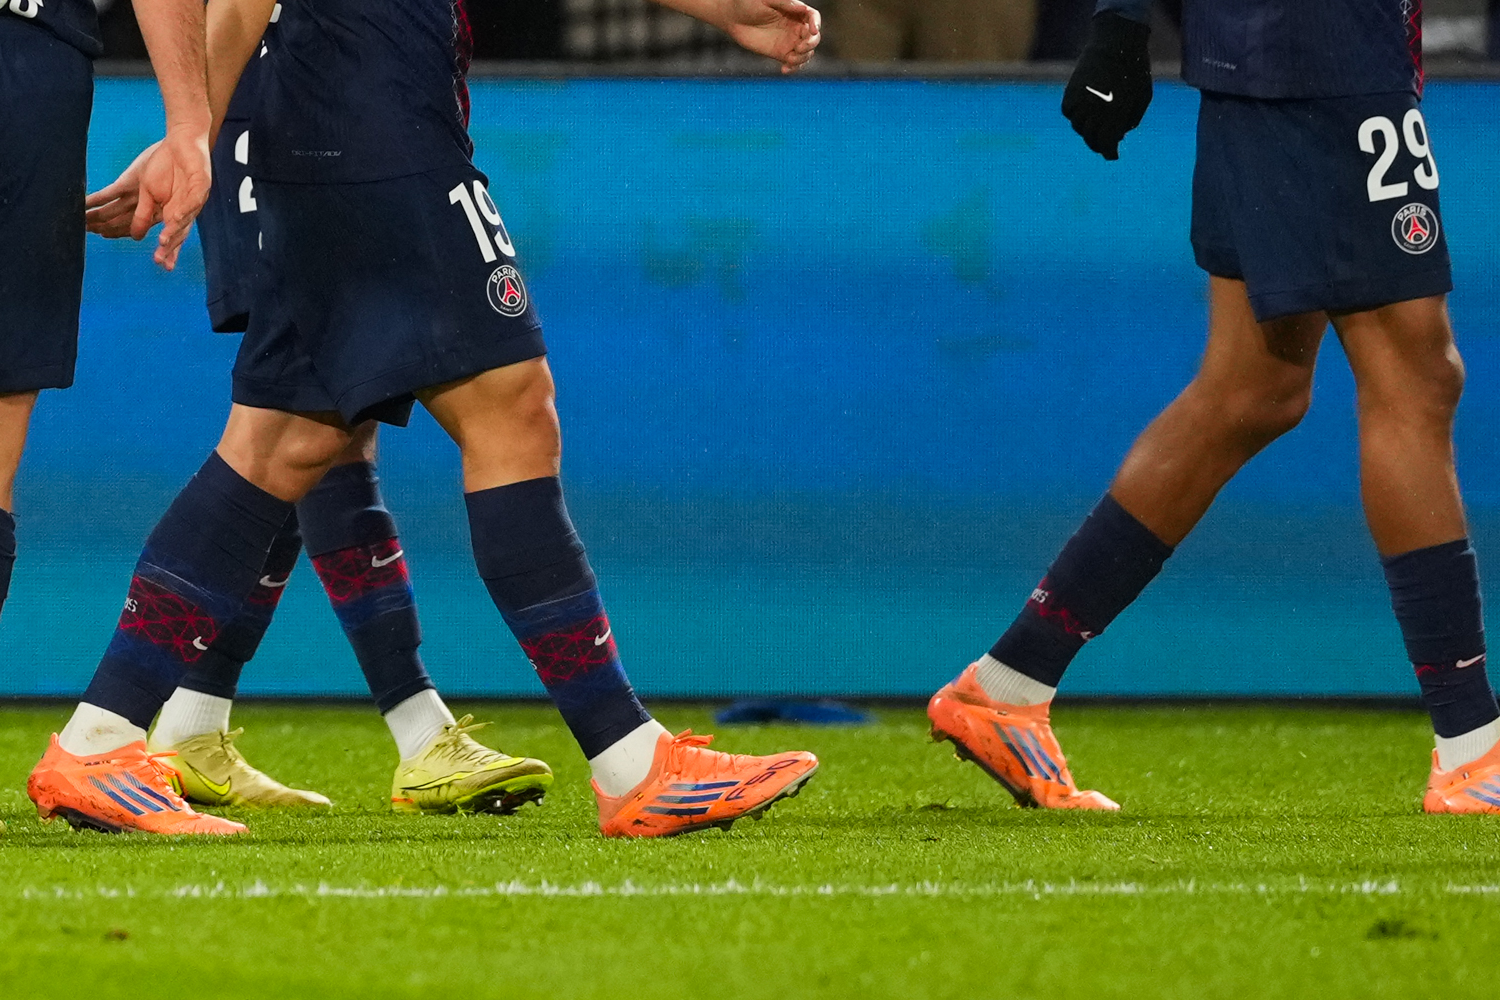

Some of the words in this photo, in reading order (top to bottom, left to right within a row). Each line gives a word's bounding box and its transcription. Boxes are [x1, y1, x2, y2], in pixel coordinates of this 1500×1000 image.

[1357, 108, 1440, 203] 29
[448, 179, 516, 264] 19
[1396, 205, 1427, 222] PARIS
[491, 267, 517, 284] PARIS
